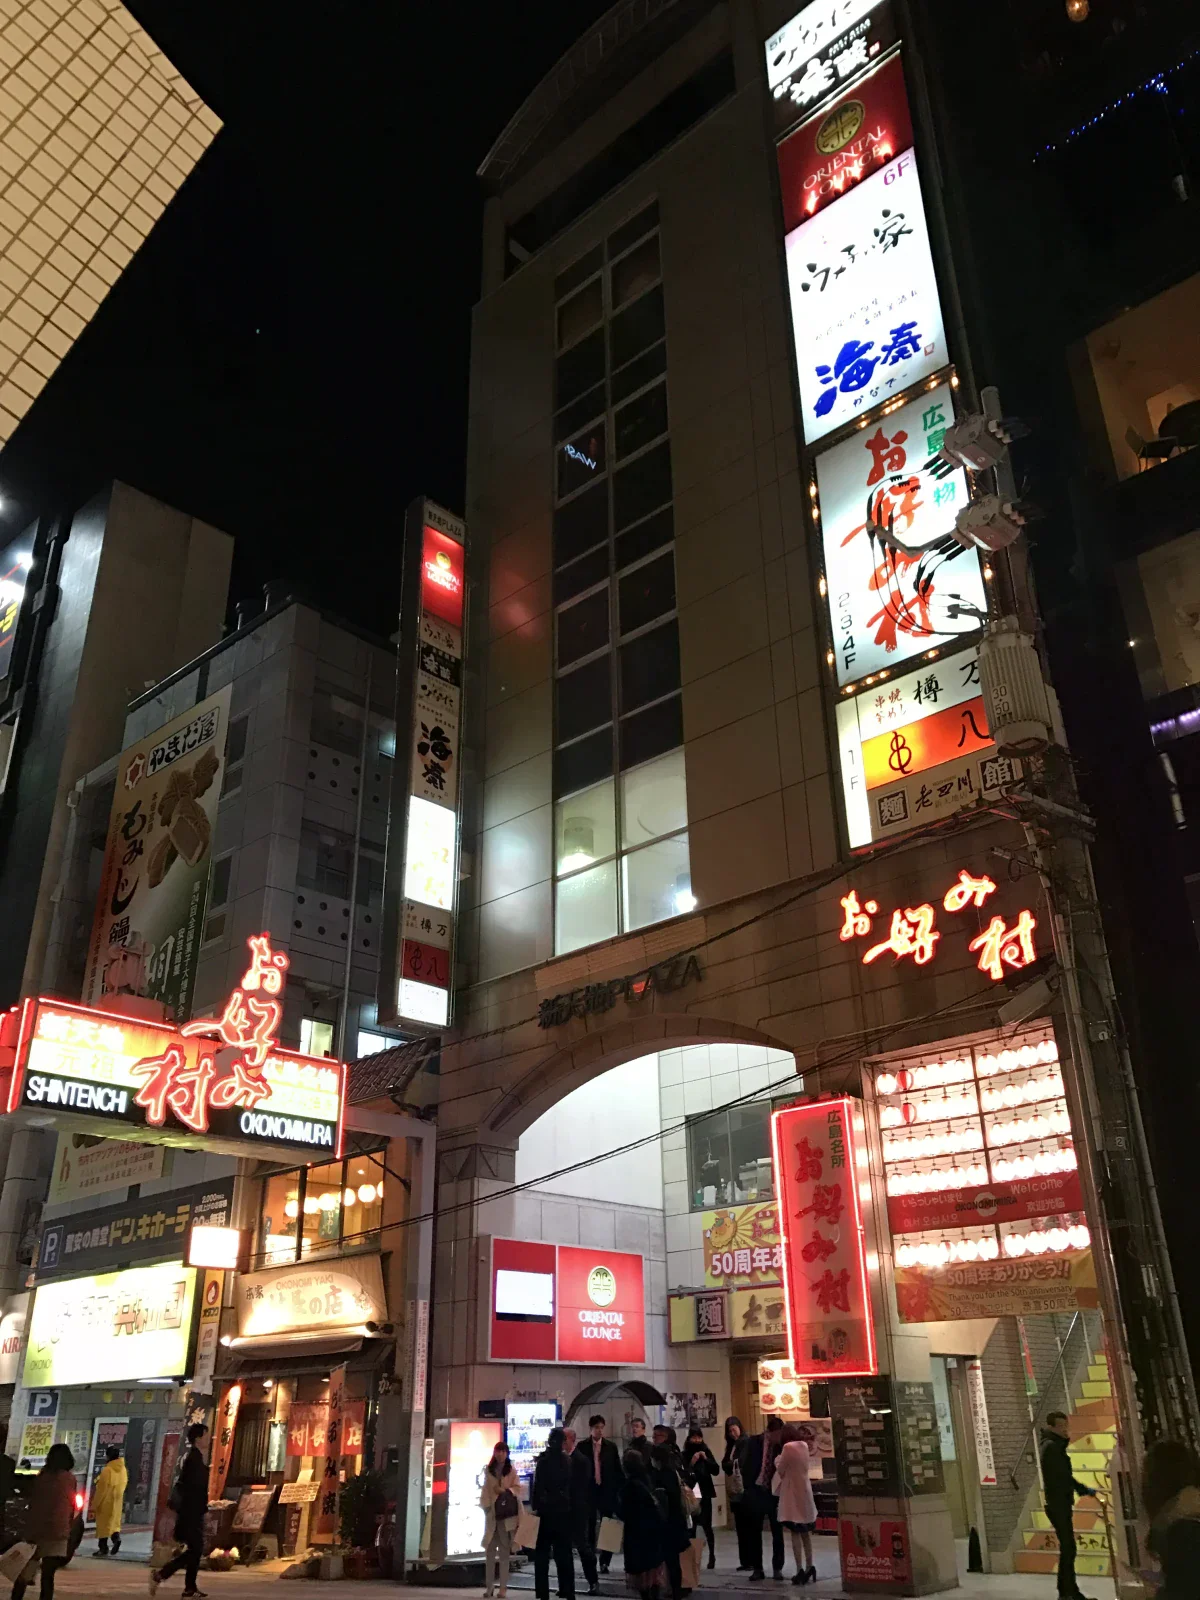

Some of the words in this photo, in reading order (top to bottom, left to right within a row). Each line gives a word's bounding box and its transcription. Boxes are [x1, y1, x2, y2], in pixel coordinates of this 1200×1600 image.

[803, 125, 886, 190] ORIENTAL
[807, 143, 882, 203] LOUNGE
[883, 154, 911, 186] 6F
[27, 1075, 127, 1114] SHINTENCHI
[827, 1109, 846, 1170] 広島名所
[948, 1293, 969, 1302] Thank
[971, 1293, 985, 1302] you
[985, 1291, 996, 1300] for
[997, 1289, 1009, 1298] the
[1029, 1285, 1073, 1296] anniversary
[578, 1309, 626, 1326] ORIENTAL
[582, 1326, 622, 1342] LOUNGE
[34, 1393, 53, 1416] P
